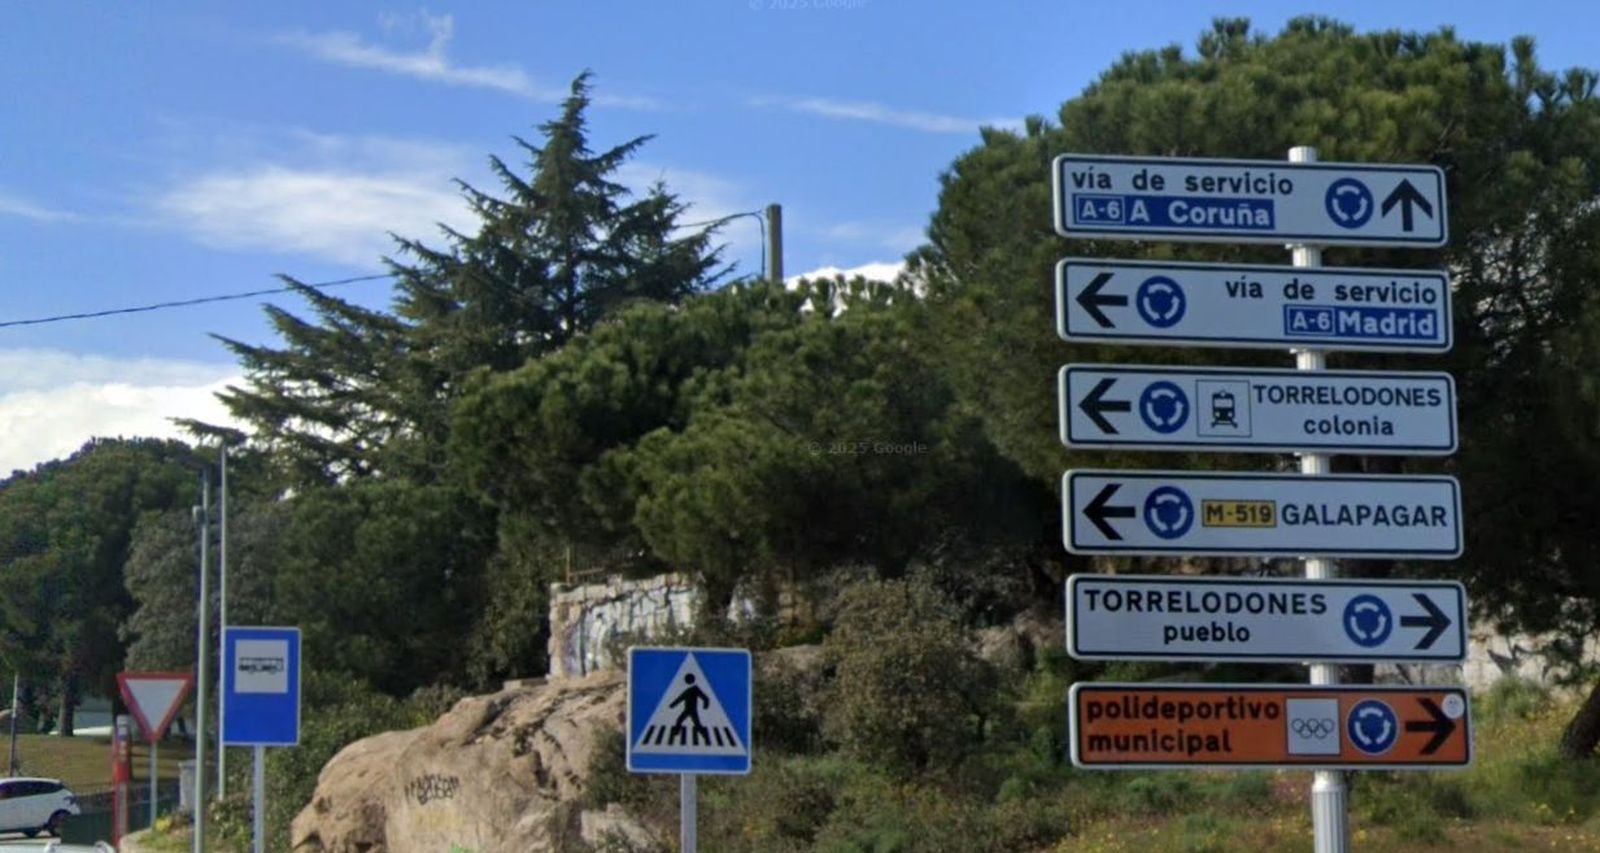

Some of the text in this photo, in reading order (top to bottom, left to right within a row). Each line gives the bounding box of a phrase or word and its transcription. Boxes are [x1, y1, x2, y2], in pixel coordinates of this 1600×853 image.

[1071, 166, 1294, 196] vía de servicio
[1080, 197, 1271, 227] A-6 A Coruña
[1225, 275, 1437, 304] vía de servicio
[1291, 311, 1435, 336] A-6 Madrid
[1252, 384, 1442, 408] TORRELODONES
[1303, 414, 1394, 437] colonia
[1205, 502, 1448, 528] M-519 GALAPAGAR
[1084, 589, 1328, 615] TORRELODONES
[1163, 621, 1250, 645] pueblo
[1086, 696, 1280, 724] polideportivo
[1087, 729, 1232, 757] municipal
